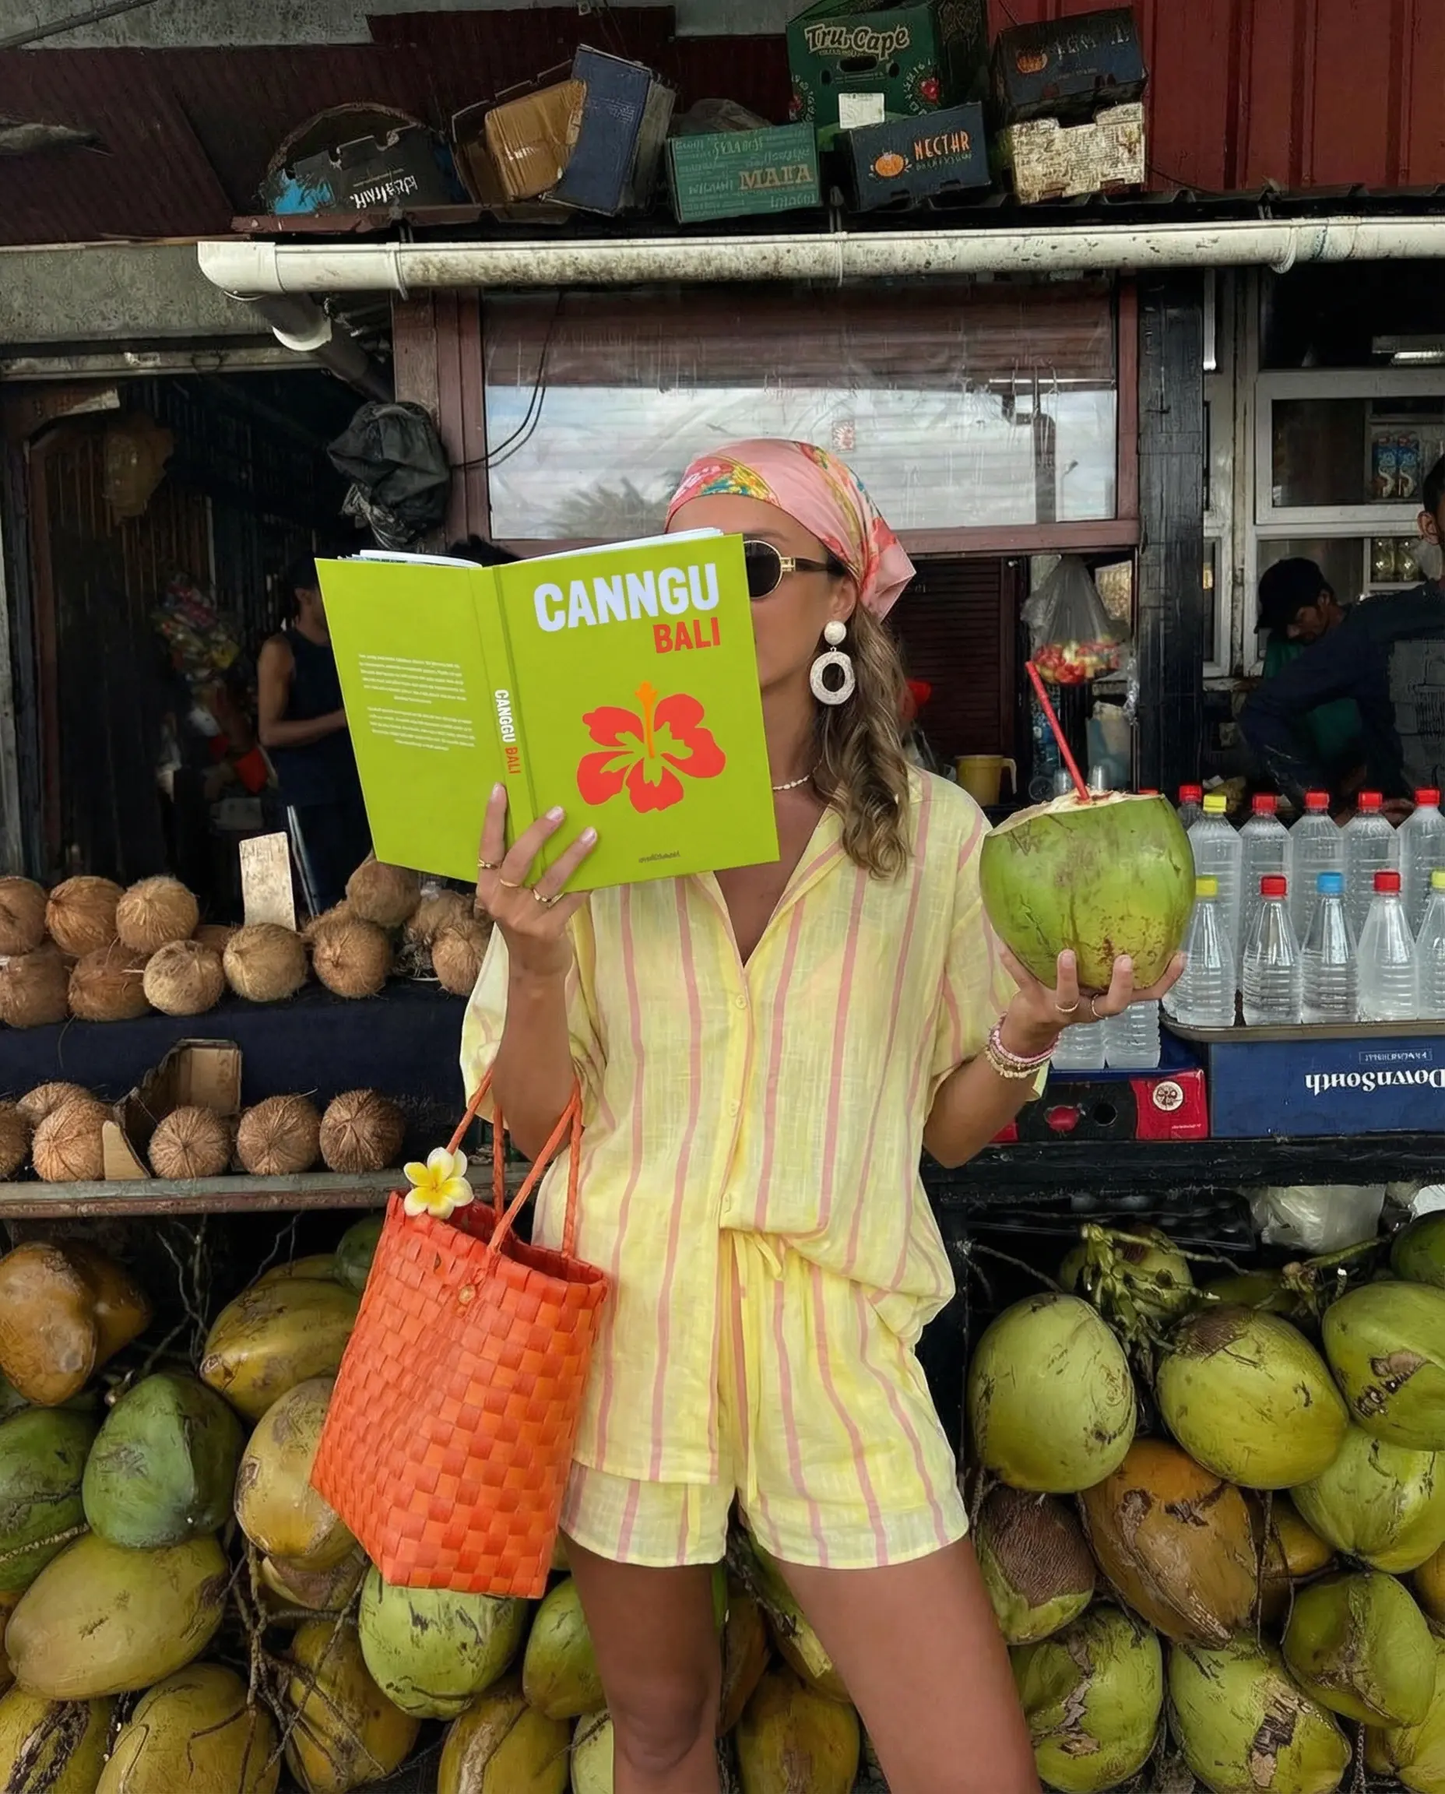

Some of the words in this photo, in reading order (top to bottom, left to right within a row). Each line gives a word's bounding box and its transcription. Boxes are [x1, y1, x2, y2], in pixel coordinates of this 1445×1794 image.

[533, 563, 720, 632] CANNGU
[653, 617, 721, 654] BALI
[495, 689, 516, 743] CANGGU
[505, 746, 522, 775] BALI
